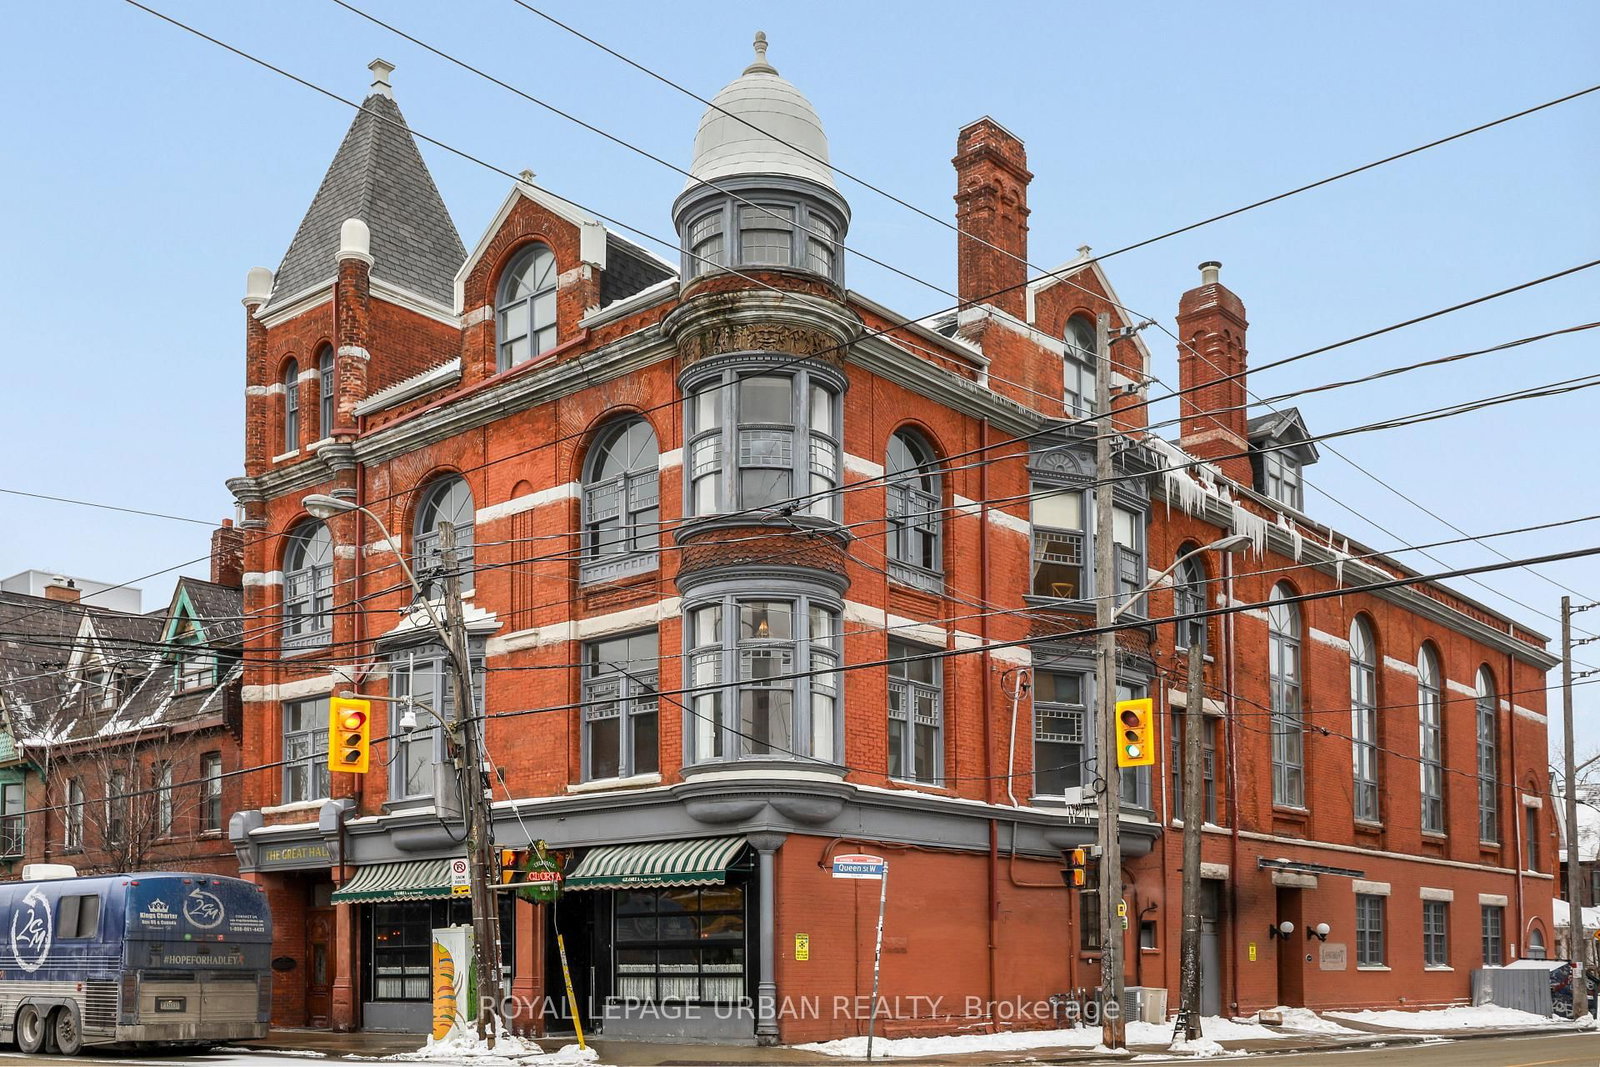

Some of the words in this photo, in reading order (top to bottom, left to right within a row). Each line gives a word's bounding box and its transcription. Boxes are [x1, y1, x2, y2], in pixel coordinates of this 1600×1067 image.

[266, 850, 280, 861] THE
[282, 847, 307, 860] GREAT
[838, 864, 862, 872] Queen
[528, 871, 562, 881] GLORIA
[140, 912, 156, 920] Kings
[156, 912, 178, 920] Charter
[163, 955, 238, 965] #HOPEFORHADLEY
